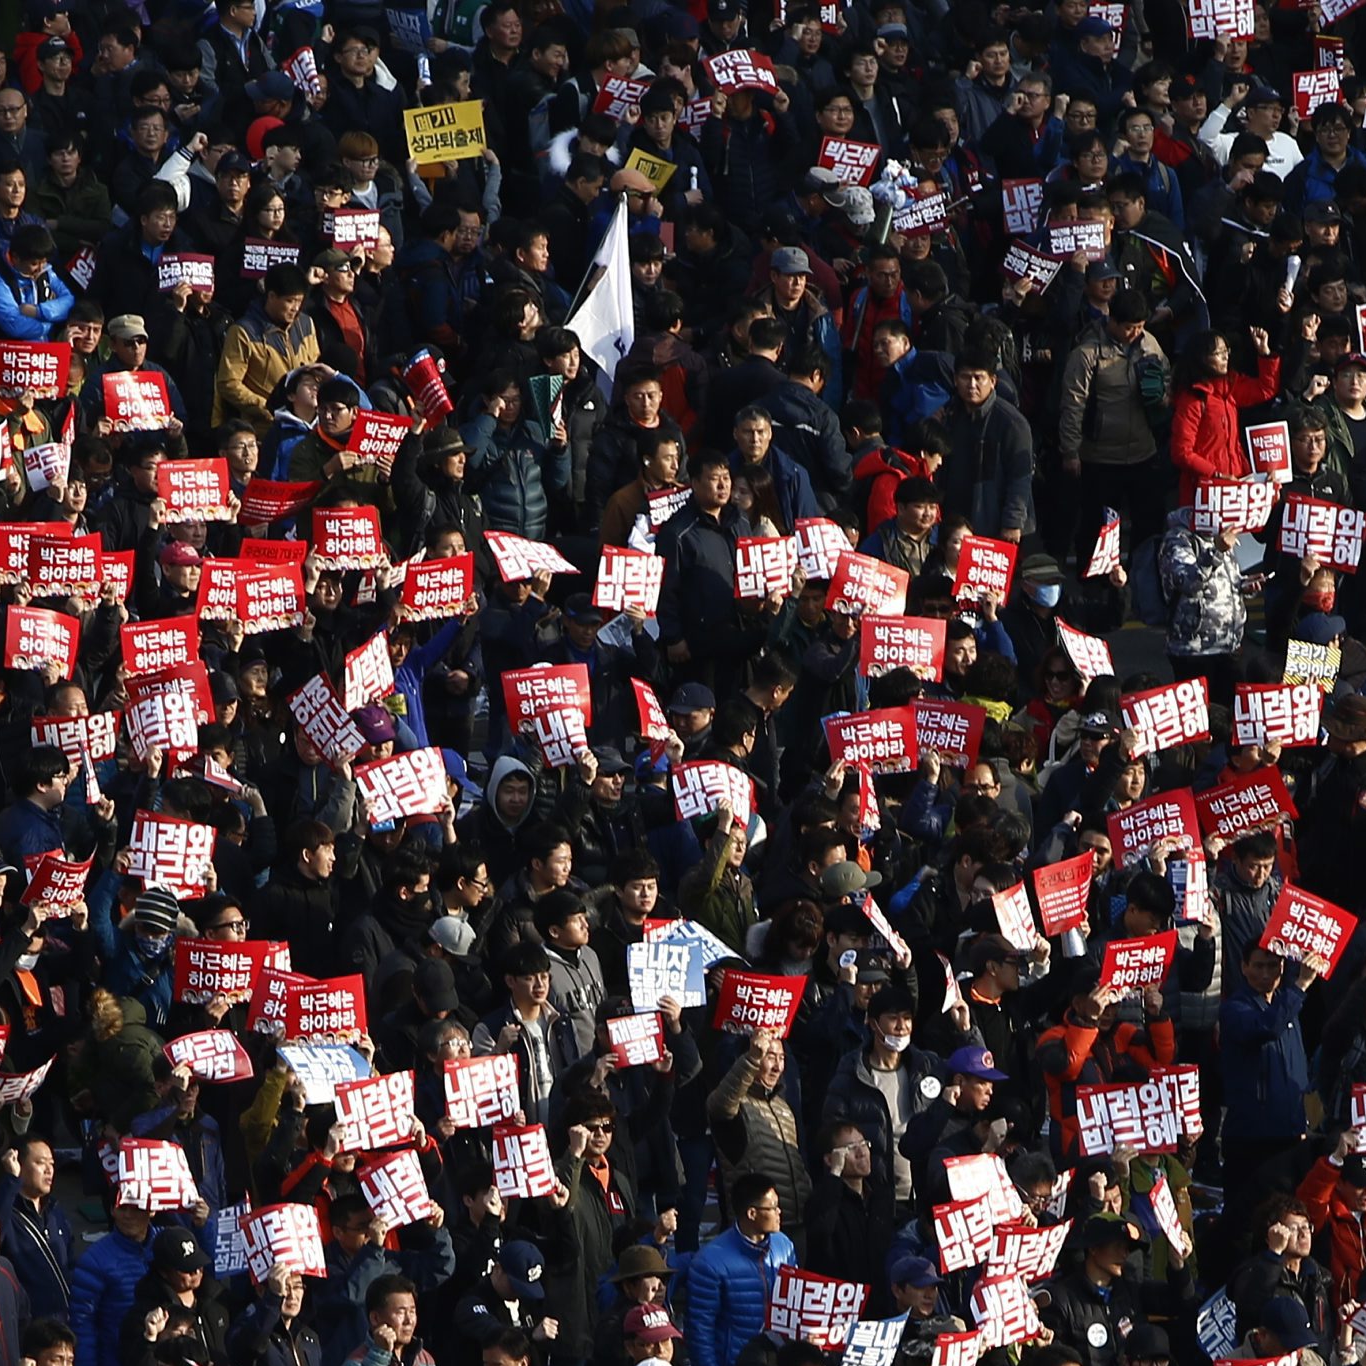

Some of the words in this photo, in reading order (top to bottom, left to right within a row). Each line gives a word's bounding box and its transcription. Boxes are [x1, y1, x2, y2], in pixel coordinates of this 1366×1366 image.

[717, 63, 775, 90] 박근혜
[1297, 70, 1338, 91] 박근혜
[411, 130, 482, 153] 성과퇴출제
[825, 139, 880, 167] 박근혜
[334, 221, 356, 241] 전원
[1050, 236, 1074, 253] 전원
[3, 351, 59, 368] 박근혜는
[2, 367, 57, 386] 하야하라
[1252, 433, 1283, 450] 박근혜
[170, 487, 220, 507] 하야하라
[1194, 483, 1272, 512] 내려와
[325, 520, 375, 537] 박근혜는
[1283, 503, 1364, 538] 내려와
[325, 537, 375, 555] 하야하라
[40, 548, 94, 566] 박근혜는
[38, 564, 95, 584] 하야하라
[601, 555, 664, 584] 내려와
[246, 577, 296, 598] 박근혜는
[414, 585, 464, 605] 하야하라
[247, 595, 296, 616] 하야하라
[132, 633, 186, 650] 박근혜는
[875, 627, 933, 646] 박근혜는
[875, 643, 932, 664] 하야하라
[1236, 687, 1319, 719] 내려와
[841, 722, 902, 742] 박근혜는
[843, 738, 905, 762] 하야하라
[357, 748, 442, 799] 내려와
[1210, 785, 1271, 814] 박근혜는
[1120, 804, 1179, 830] 박근혜는
[1217, 800, 1278, 833] 하야하라
[132, 820, 213, 850] 내려와
[191, 951, 251, 969] 박근혜는
[1114, 947, 1165, 968] 박근혜는
[189, 969, 249, 988] 하야하라
[1111, 964, 1162, 987] 하야하라
[300, 991, 353, 1012] 박근혜는
[736, 987, 791, 1007] 박근혜는
[300, 1009, 354, 1030] 하야하라
[731, 1003, 786, 1026] 하야하라
[608, 1013, 659, 1044] 재벌도
[172, 1033, 236, 1060] 박근혜
[445, 1056, 517, 1098] 내려와
[340, 1070, 412, 1121] 내려와
[1077, 1086, 1173, 1129] 내려와
[1081, 1114, 1174, 1156] 박근혜
[241, 1205, 319, 1252] 내려와
[771, 1264, 863, 1310] 내려와
